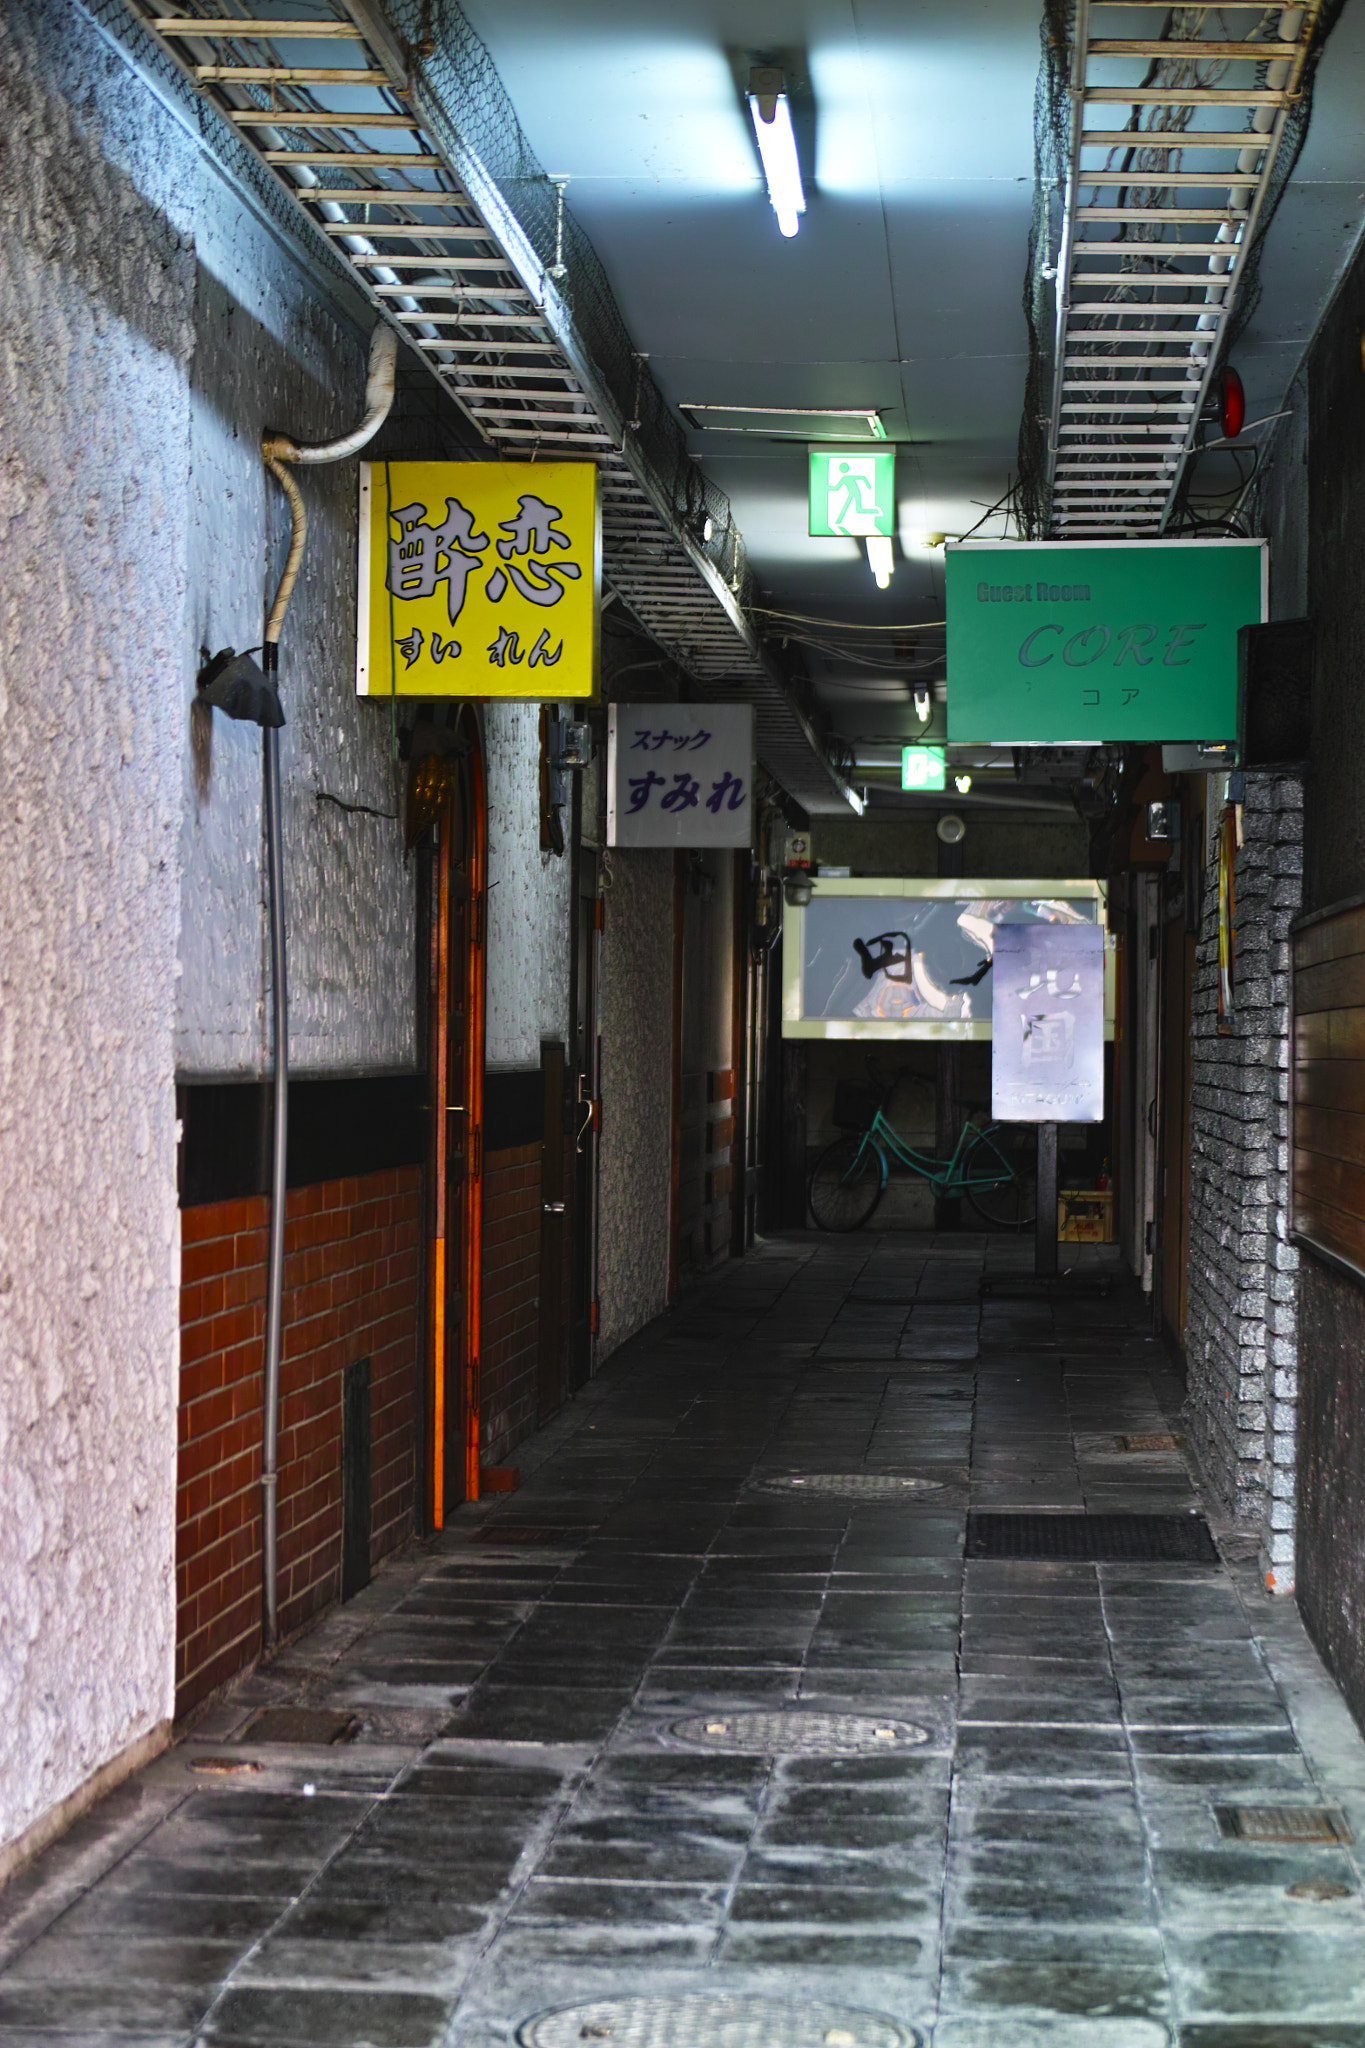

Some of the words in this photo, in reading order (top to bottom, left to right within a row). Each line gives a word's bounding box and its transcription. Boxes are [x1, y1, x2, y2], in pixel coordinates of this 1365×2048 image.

[386, 494, 582, 627] 酔恋
[977, 582, 1032, 602] Guest
[1036, 582, 1091, 601] Room
[1018, 624, 1207, 667] CORE
[630, 729, 712, 751] スナック
[624, 771, 748, 815] すみれ
